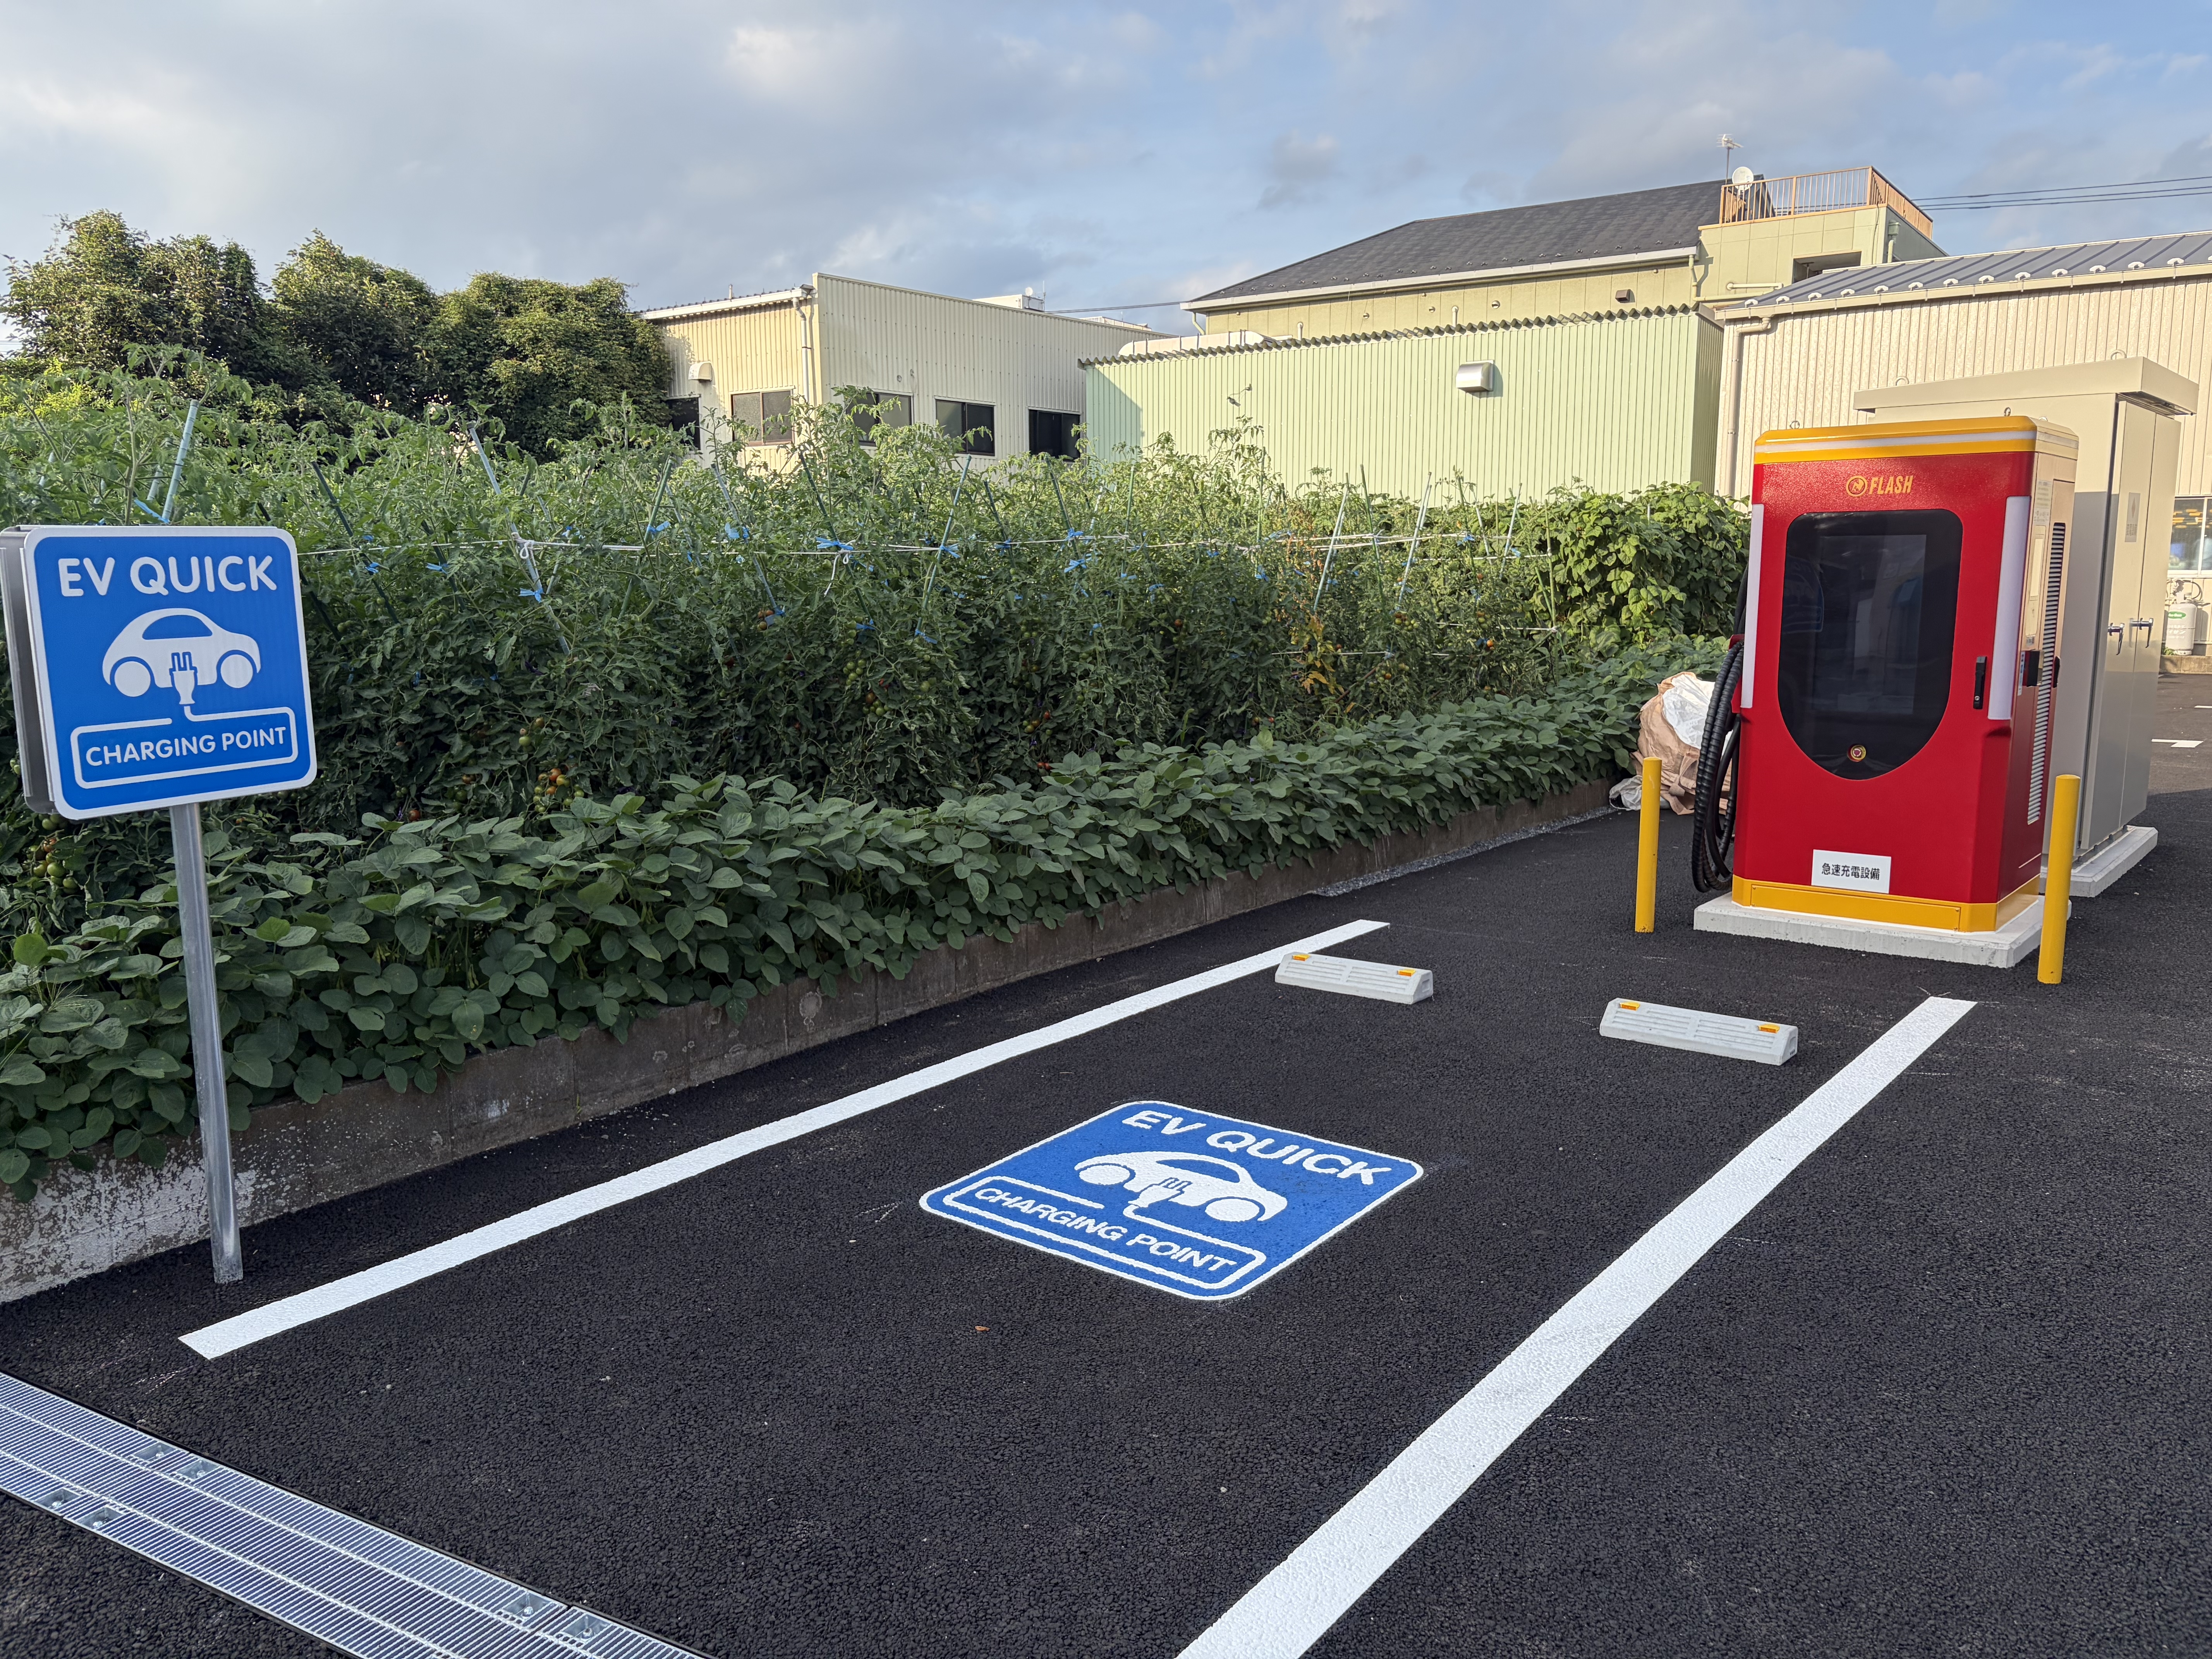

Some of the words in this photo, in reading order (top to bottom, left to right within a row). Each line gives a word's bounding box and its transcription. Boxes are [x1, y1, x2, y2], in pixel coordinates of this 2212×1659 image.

[1868, 475, 1914, 495] FLASH
[58, 557, 115, 597] EV
[130, 555, 277, 596] QUICK
[86, 735, 216, 766] CHARGING
[222, 726, 286, 751] POINT
[1822, 862, 1880, 880] 急速充電設備
[1122, 1110, 1207, 1135] EV
[1206, 1130, 1393, 1185] QUICK
[974, 1187, 1128, 1241] CHARGING
[1125, 1233, 1238, 1271] POINT
